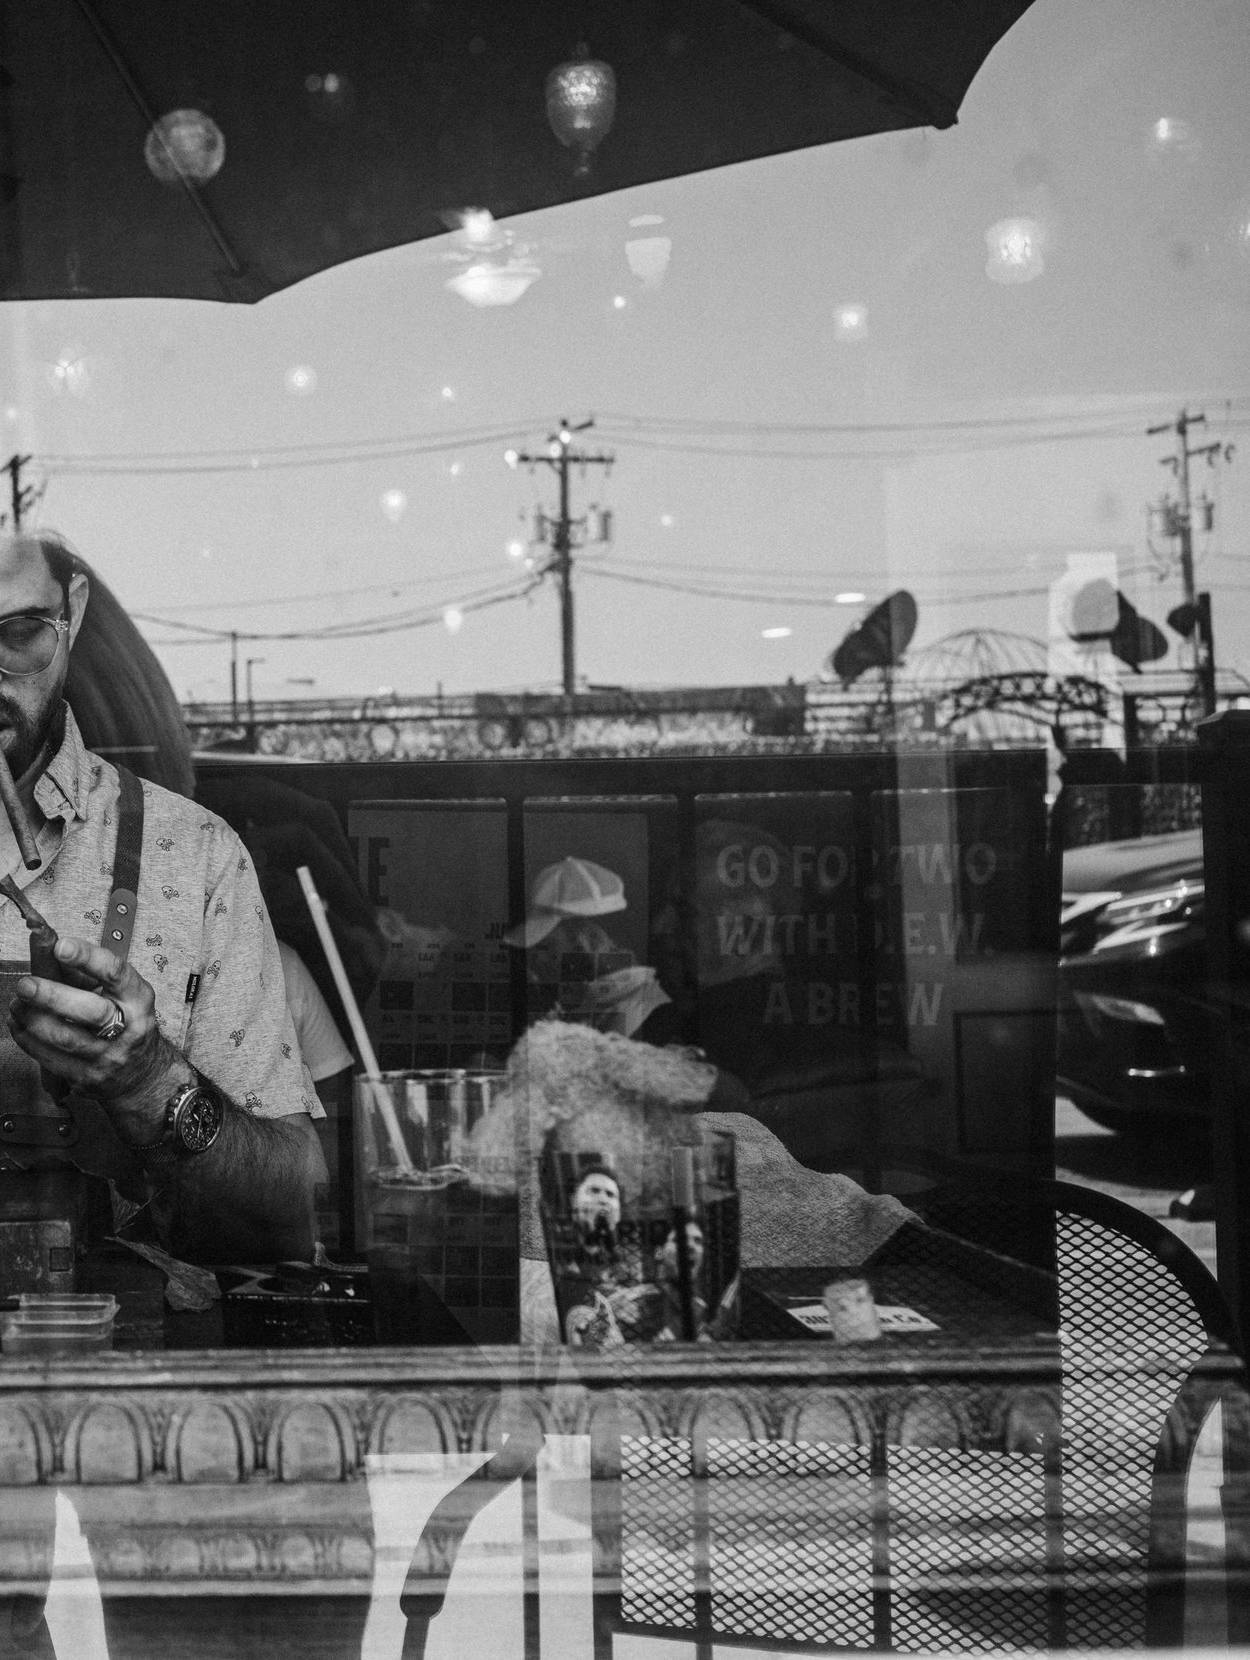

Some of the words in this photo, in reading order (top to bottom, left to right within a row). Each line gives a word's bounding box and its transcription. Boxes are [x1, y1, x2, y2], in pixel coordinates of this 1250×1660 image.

[716, 844, 779, 888] GO
[889, 843, 997, 885] TWO
[716, 912, 838, 955] WITH
[763, 981, 793, 1025] A
[807, 981, 945, 1026] BREW
